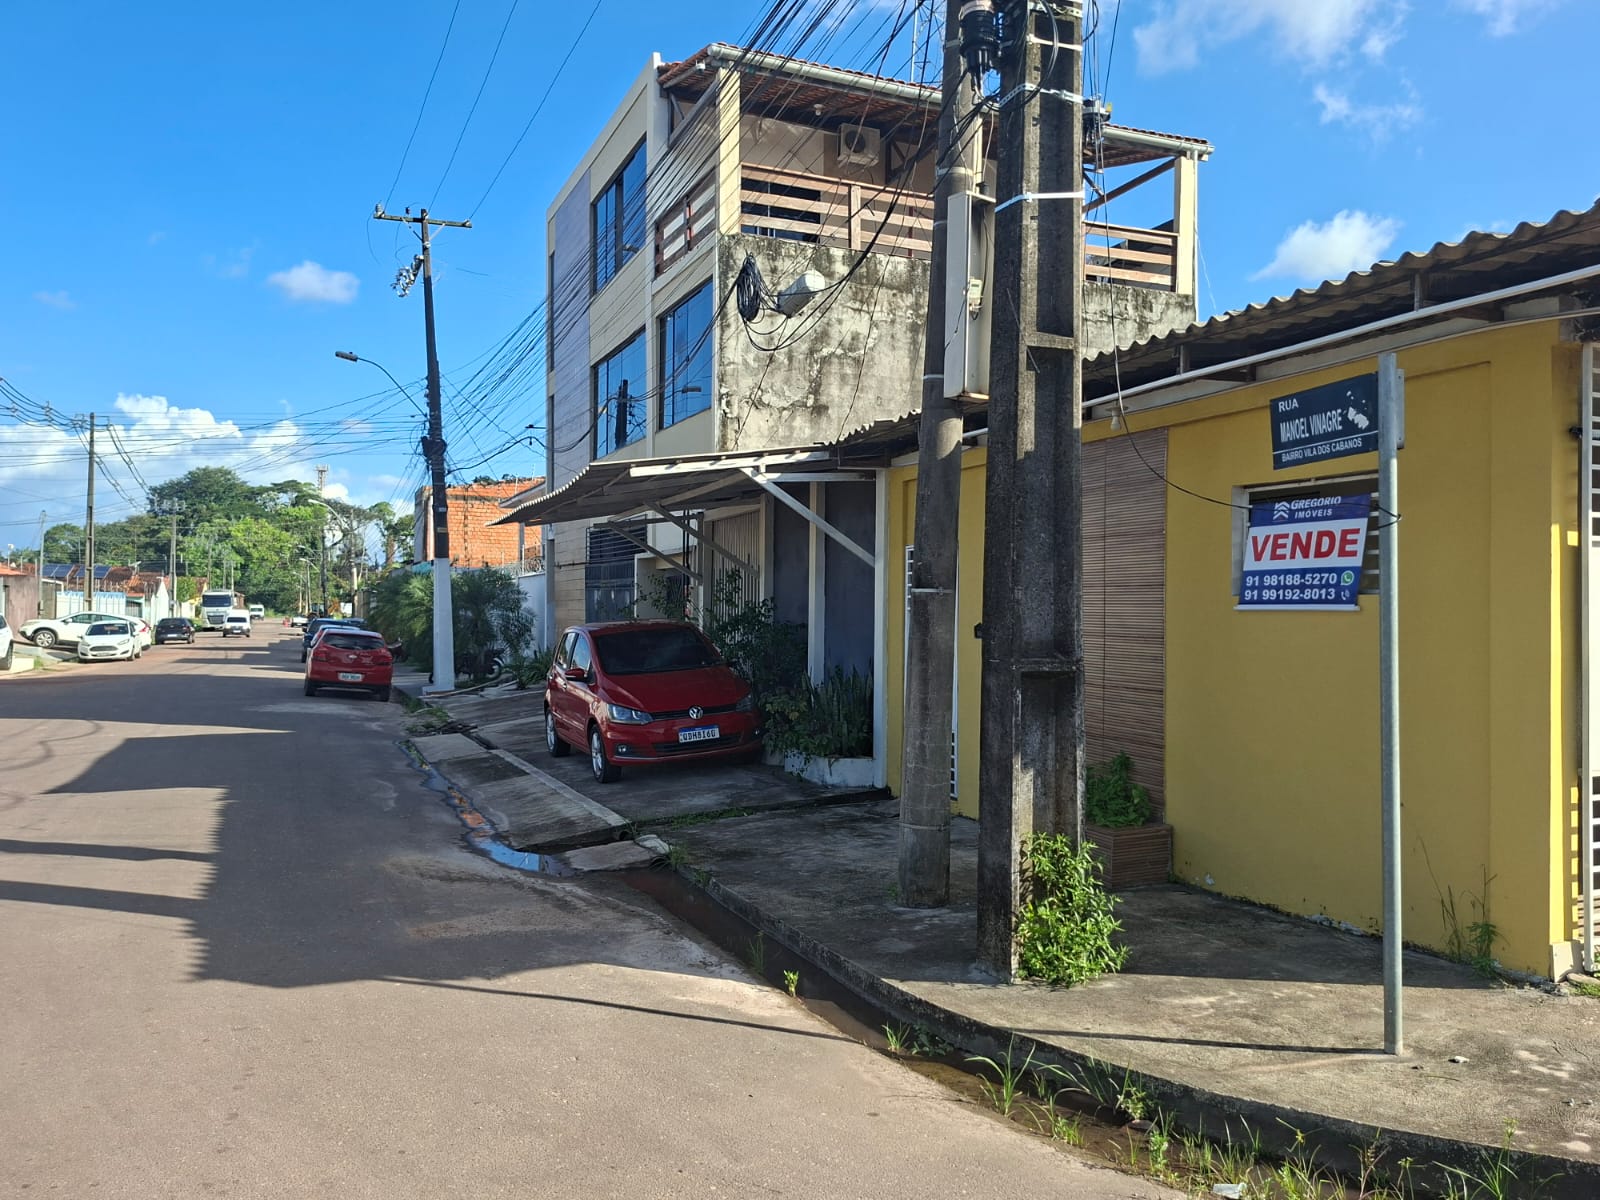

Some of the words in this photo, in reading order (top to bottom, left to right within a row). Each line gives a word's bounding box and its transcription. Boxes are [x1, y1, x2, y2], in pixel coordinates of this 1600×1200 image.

[1278, 398, 1299, 413] RUA
[1280, 417, 1309, 443] MANOEL
[1309, 409, 1342, 436] VINAGRE
[1281, 450, 1304, 462] BAIRRO
[1303, 447, 1318, 458] VILA
[1317, 444, 1331, 455] DOS
[1331, 438, 1362, 452] CABANOS
[1251, 528, 1361, 562] VENDE
[1246, 575, 1259, 586] 91
[1263, 573, 1338, 586] 98188-5270
[1244, 589, 1258, 600] 91
[1262, 588, 1336, 600] 99192-8013
